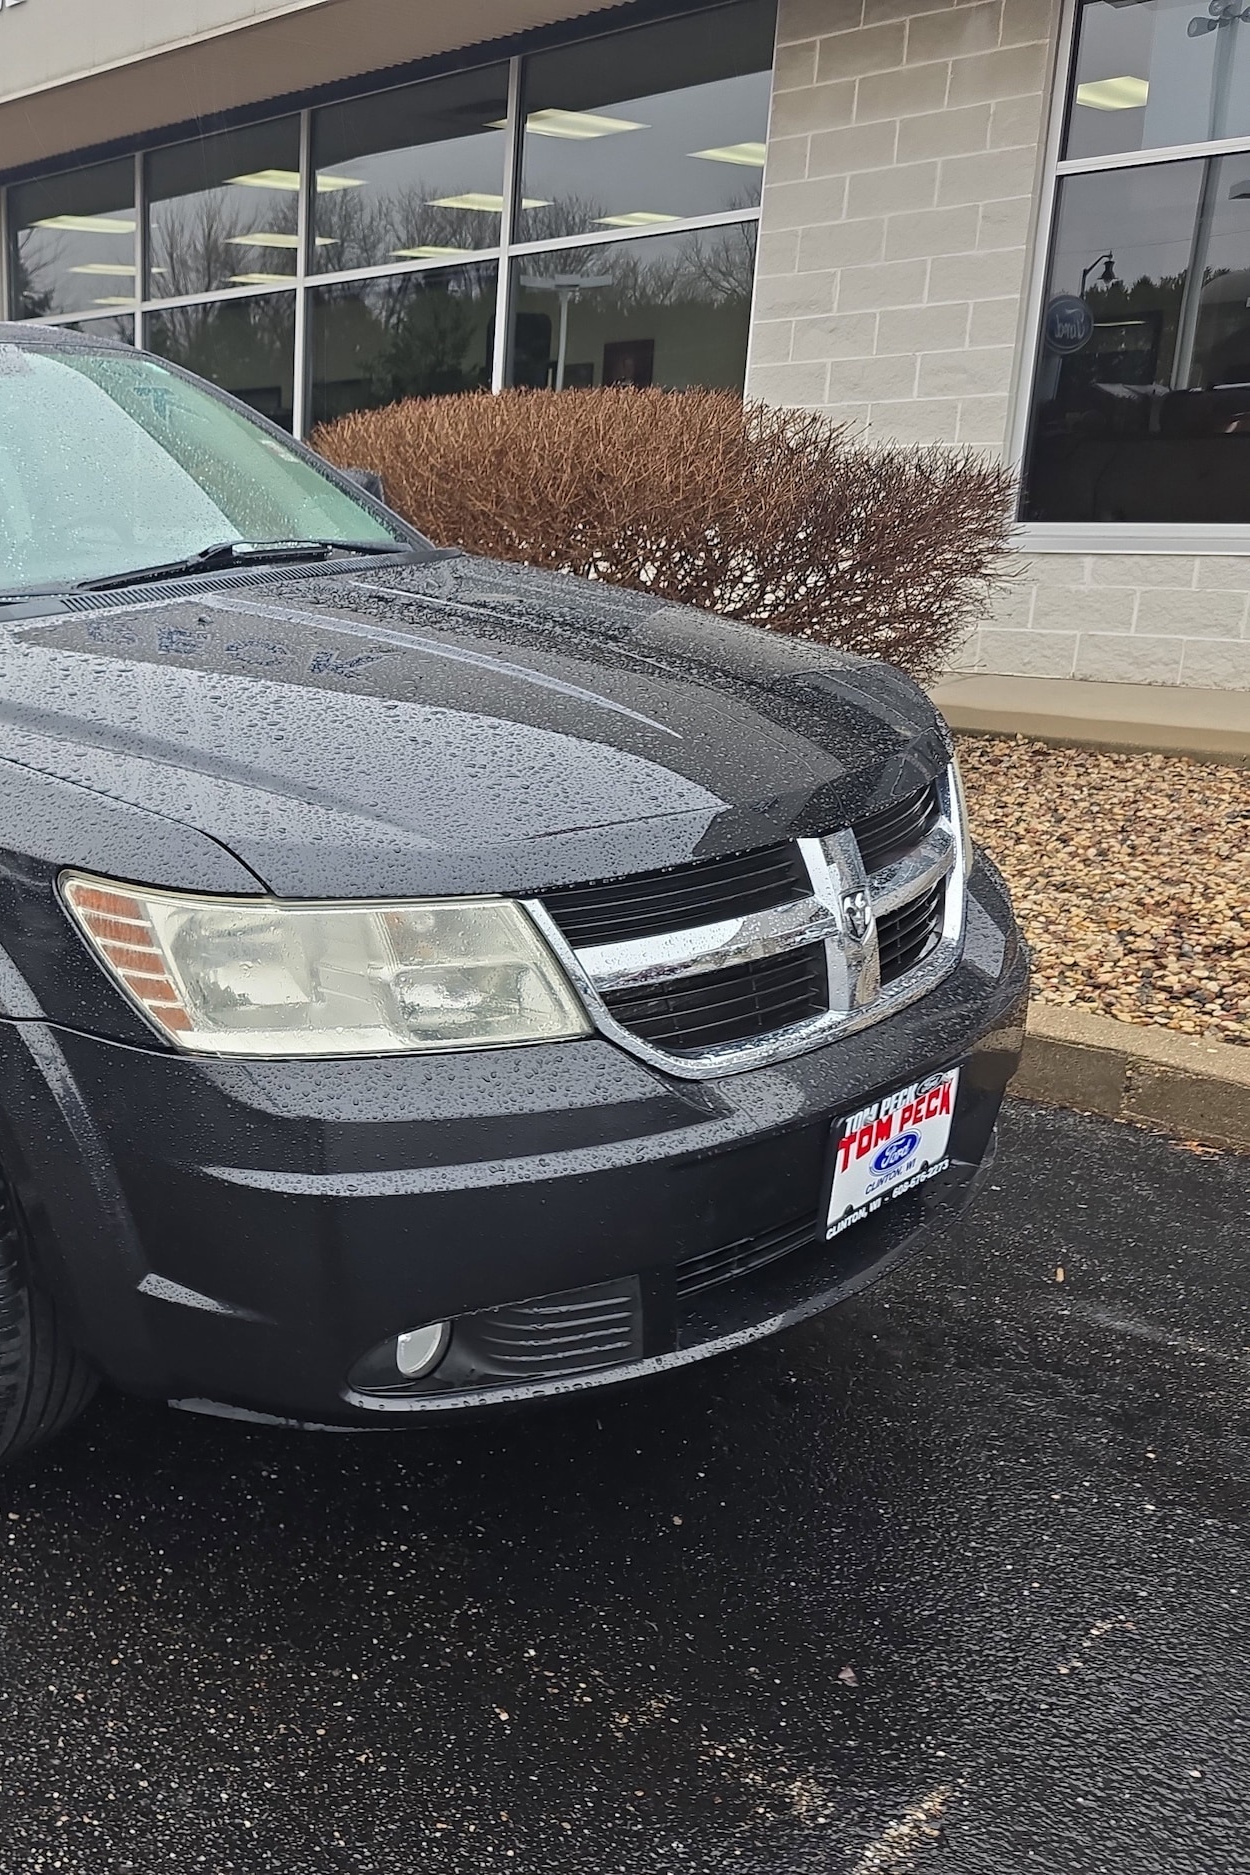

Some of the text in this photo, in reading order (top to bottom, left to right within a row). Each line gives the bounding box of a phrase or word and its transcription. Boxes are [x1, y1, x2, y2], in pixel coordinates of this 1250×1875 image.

[880, 1083, 919, 1119] PECK
[838, 1079, 953, 1174] TOM PECK
[881, 1138, 912, 1168] Ford
[905, 1158, 917, 1171] WI
[826, 1206, 868, 1240] CLINTON,
[869, 1197, 882, 1212] WI
